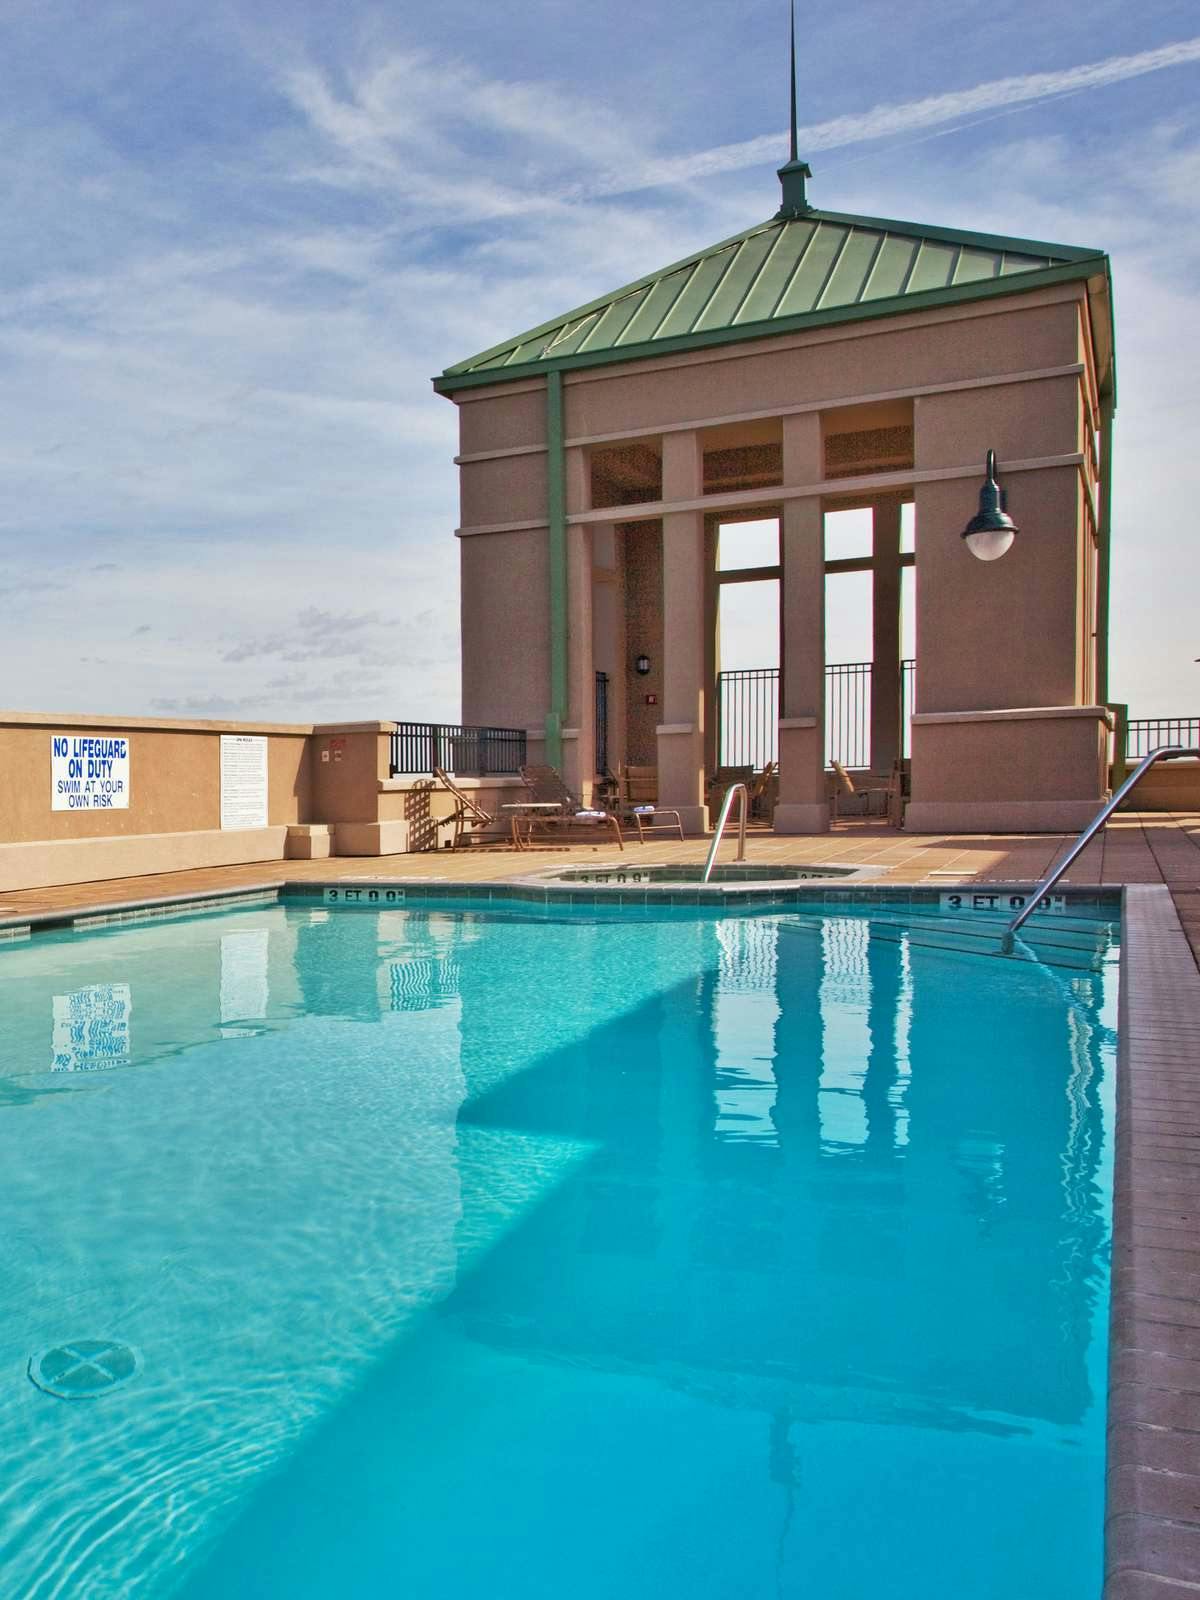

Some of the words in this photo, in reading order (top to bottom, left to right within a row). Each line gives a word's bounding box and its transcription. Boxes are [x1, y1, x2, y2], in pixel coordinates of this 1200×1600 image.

[54, 738, 68, 757] NO
[74, 739, 126, 758] LIFEGUARD
[68, 759, 82, 778] ON
[88, 759, 113, 778] DUTY
[57, 780, 80, 793] SWIM
[85, 780, 96, 793] AT
[100, 780, 123, 793] YOUR
[68, 795, 89, 807] OWN
[93, 794, 113, 807] RISK
